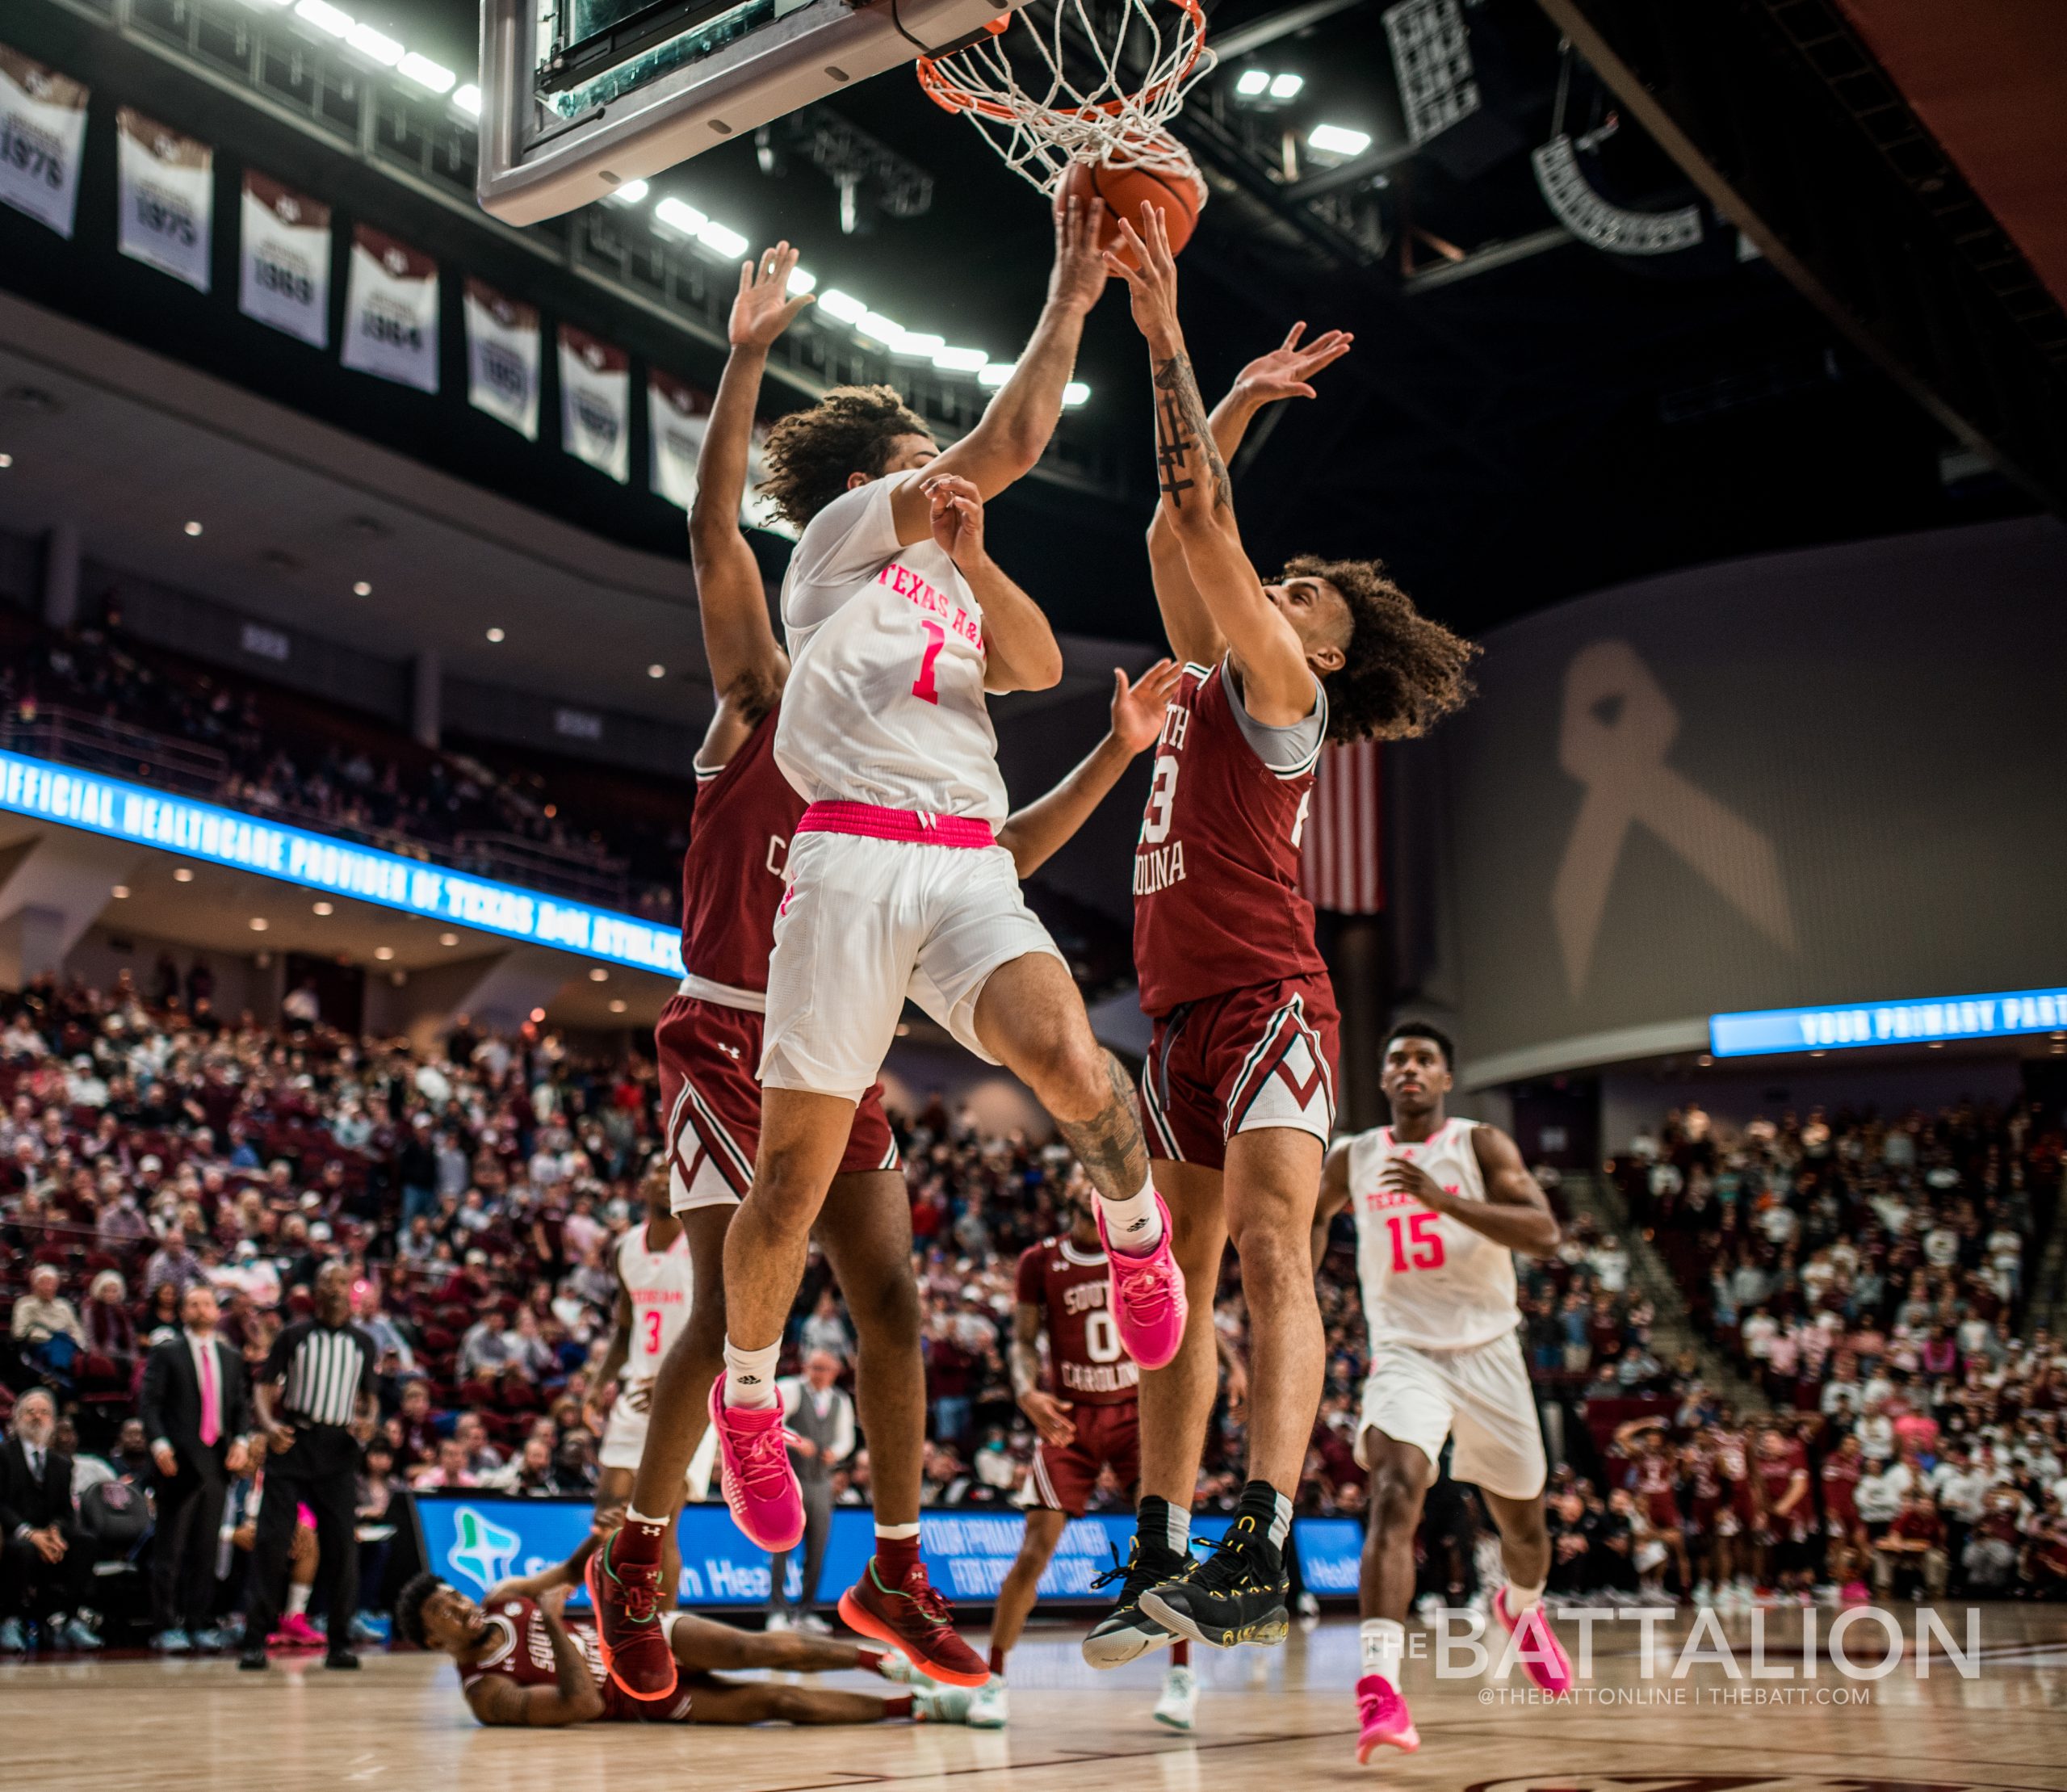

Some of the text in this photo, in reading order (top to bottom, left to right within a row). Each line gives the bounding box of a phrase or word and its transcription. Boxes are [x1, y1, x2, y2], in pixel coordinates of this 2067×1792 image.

[878, 564, 949, 619] TEXAS
[912, 619, 945, 706] 1
[123, 791, 284, 873] HEALTHCARE
[1386, 1211, 1445, 1274] 15
[644, 1310, 664, 1356] 3
[1085, 1309, 1122, 1363] 0
